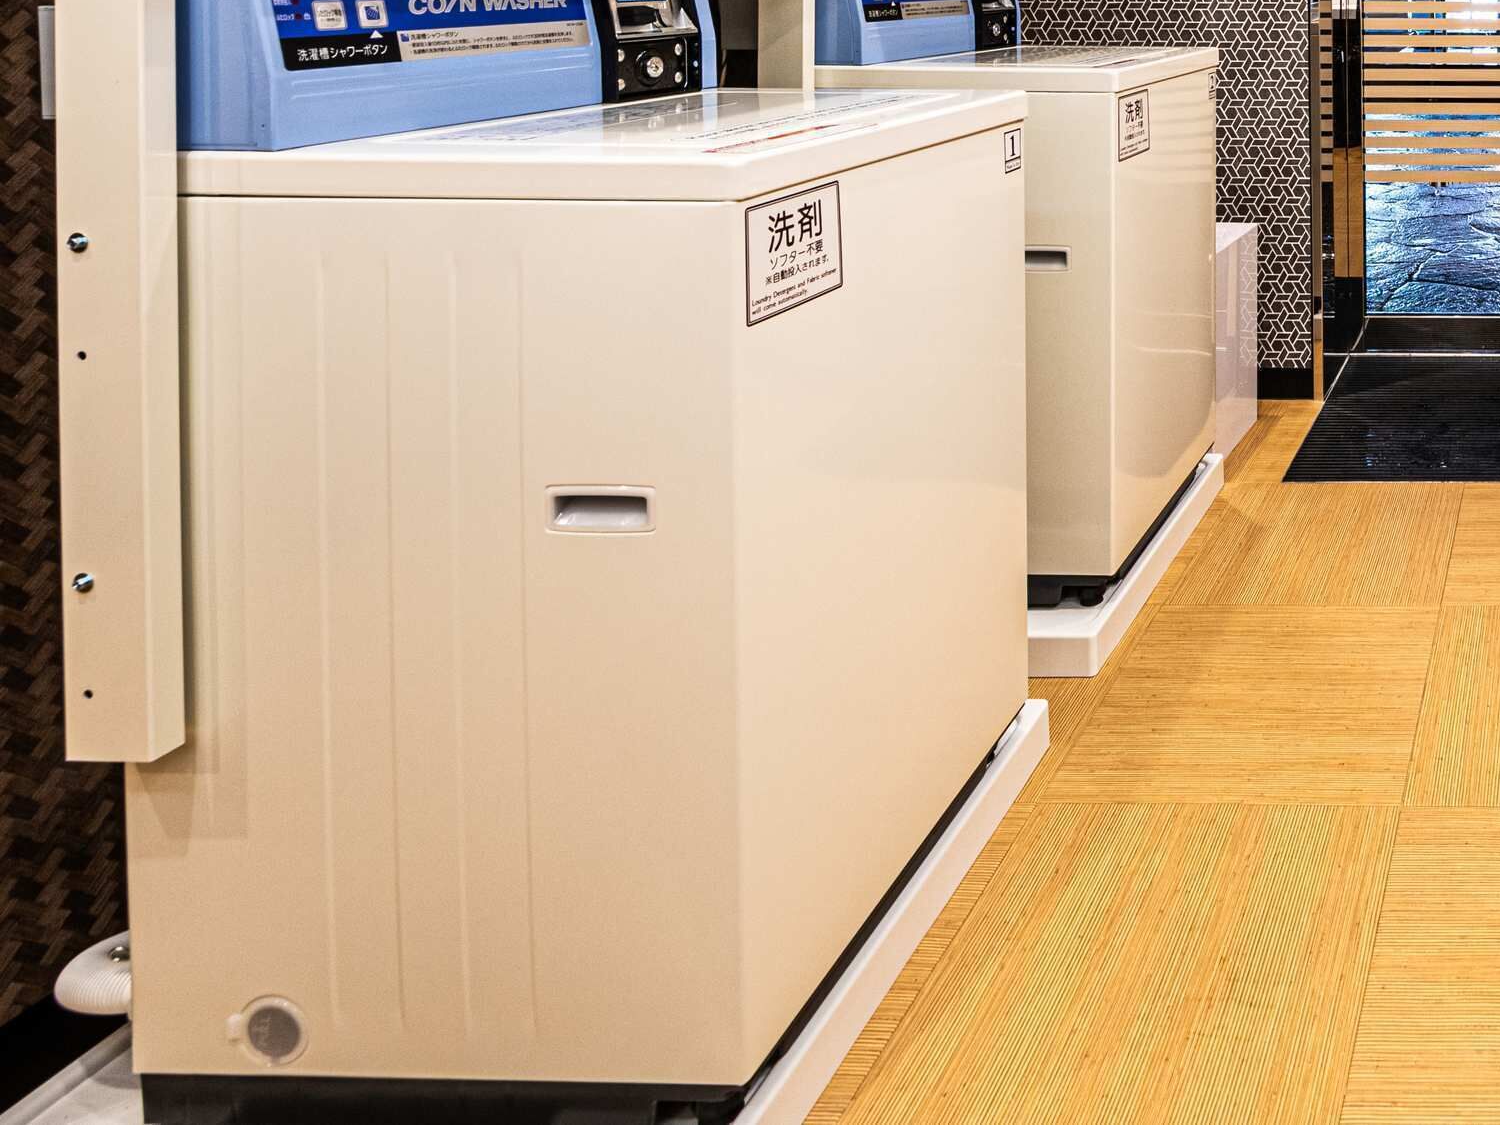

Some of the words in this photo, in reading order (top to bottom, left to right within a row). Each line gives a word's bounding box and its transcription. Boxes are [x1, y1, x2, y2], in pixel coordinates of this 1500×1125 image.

[297, 43, 388, 62] 洗濯槽シャワーボタン
[1009, 135, 1017, 157] 1
[767, 198, 823, 254] 洗剤
[769, 238, 824, 271] ソフター不要
[765, 253, 829, 286] ※自動投入されます。
[797, 280, 806, 289] and
[806, 272, 821, 284] Fabric
[752, 306, 762, 316] will
[763, 301, 777, 311] come
